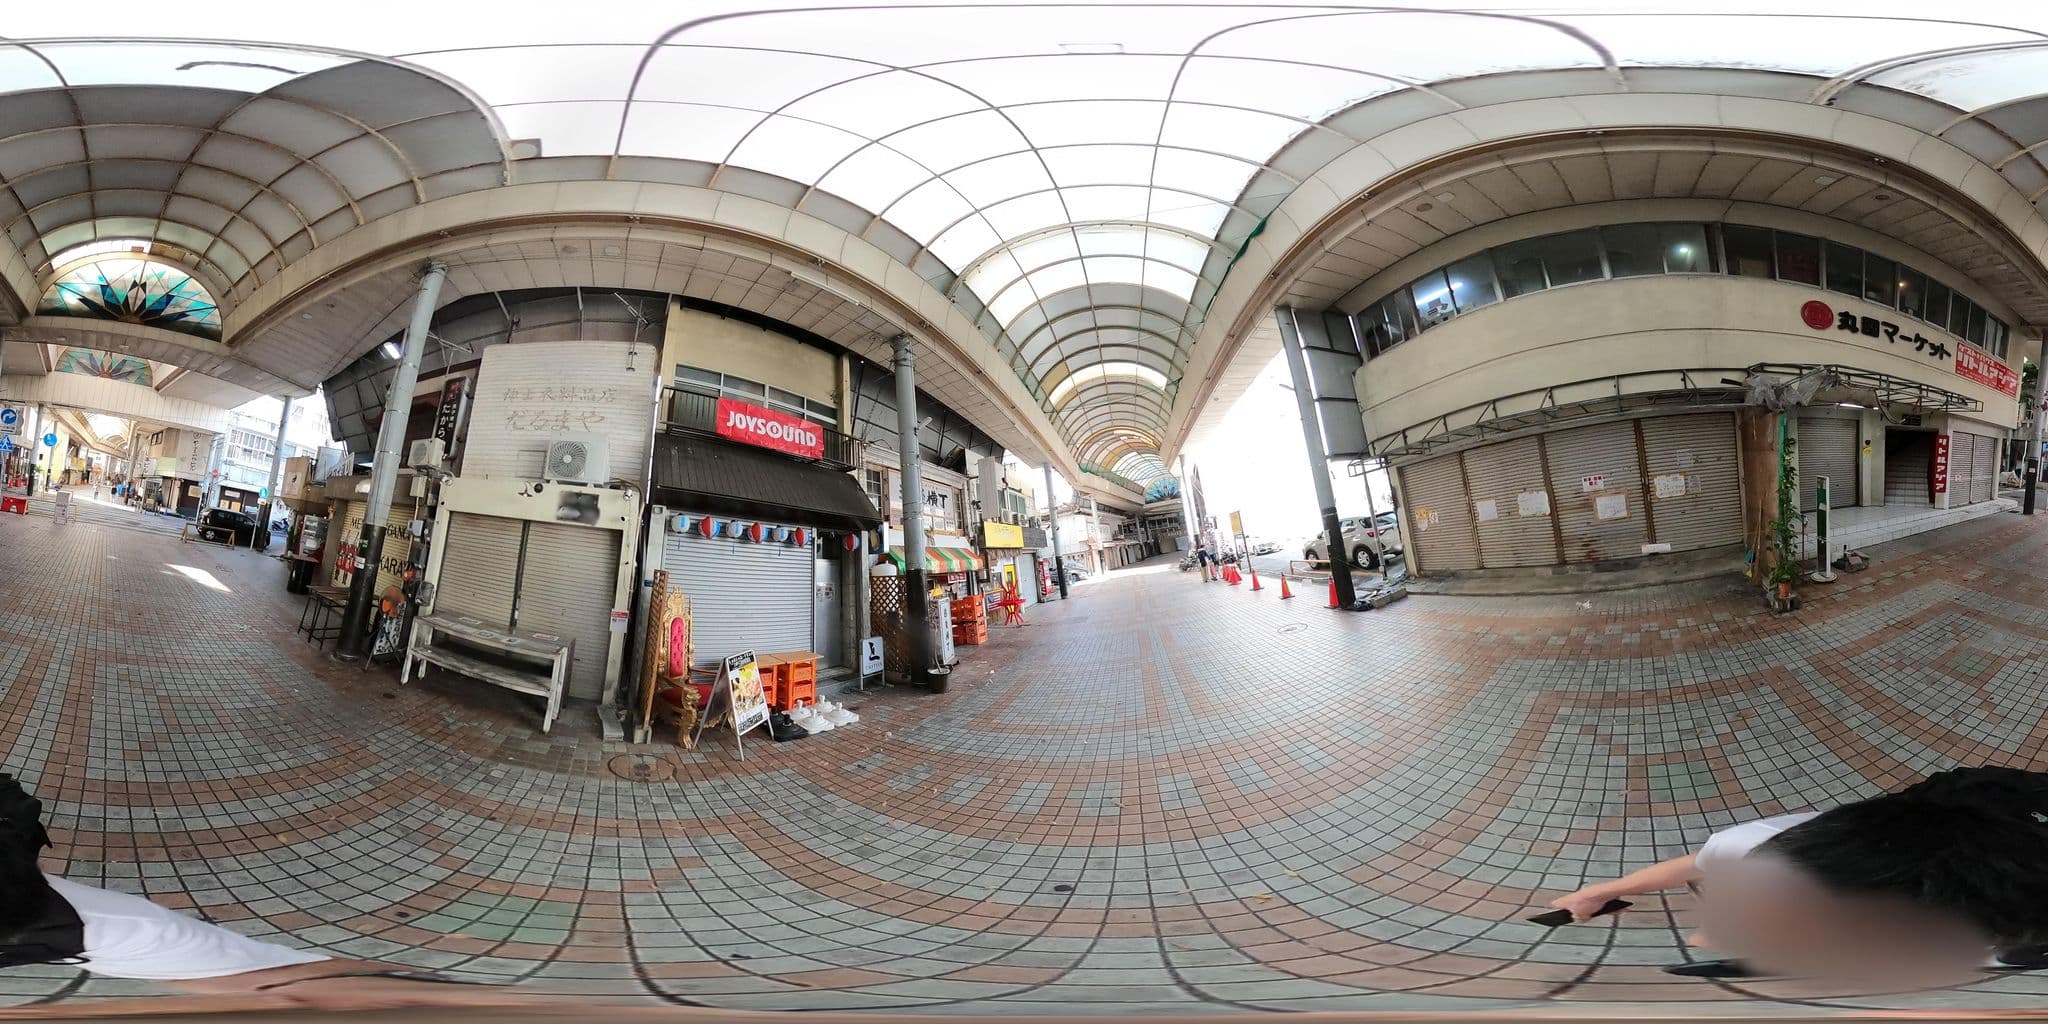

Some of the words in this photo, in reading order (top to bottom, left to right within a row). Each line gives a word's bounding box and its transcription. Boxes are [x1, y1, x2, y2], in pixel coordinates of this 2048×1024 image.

[726, 411, 817, 447] JOYSOUND
[1935, 438, 1948, 490] リトルアジア
